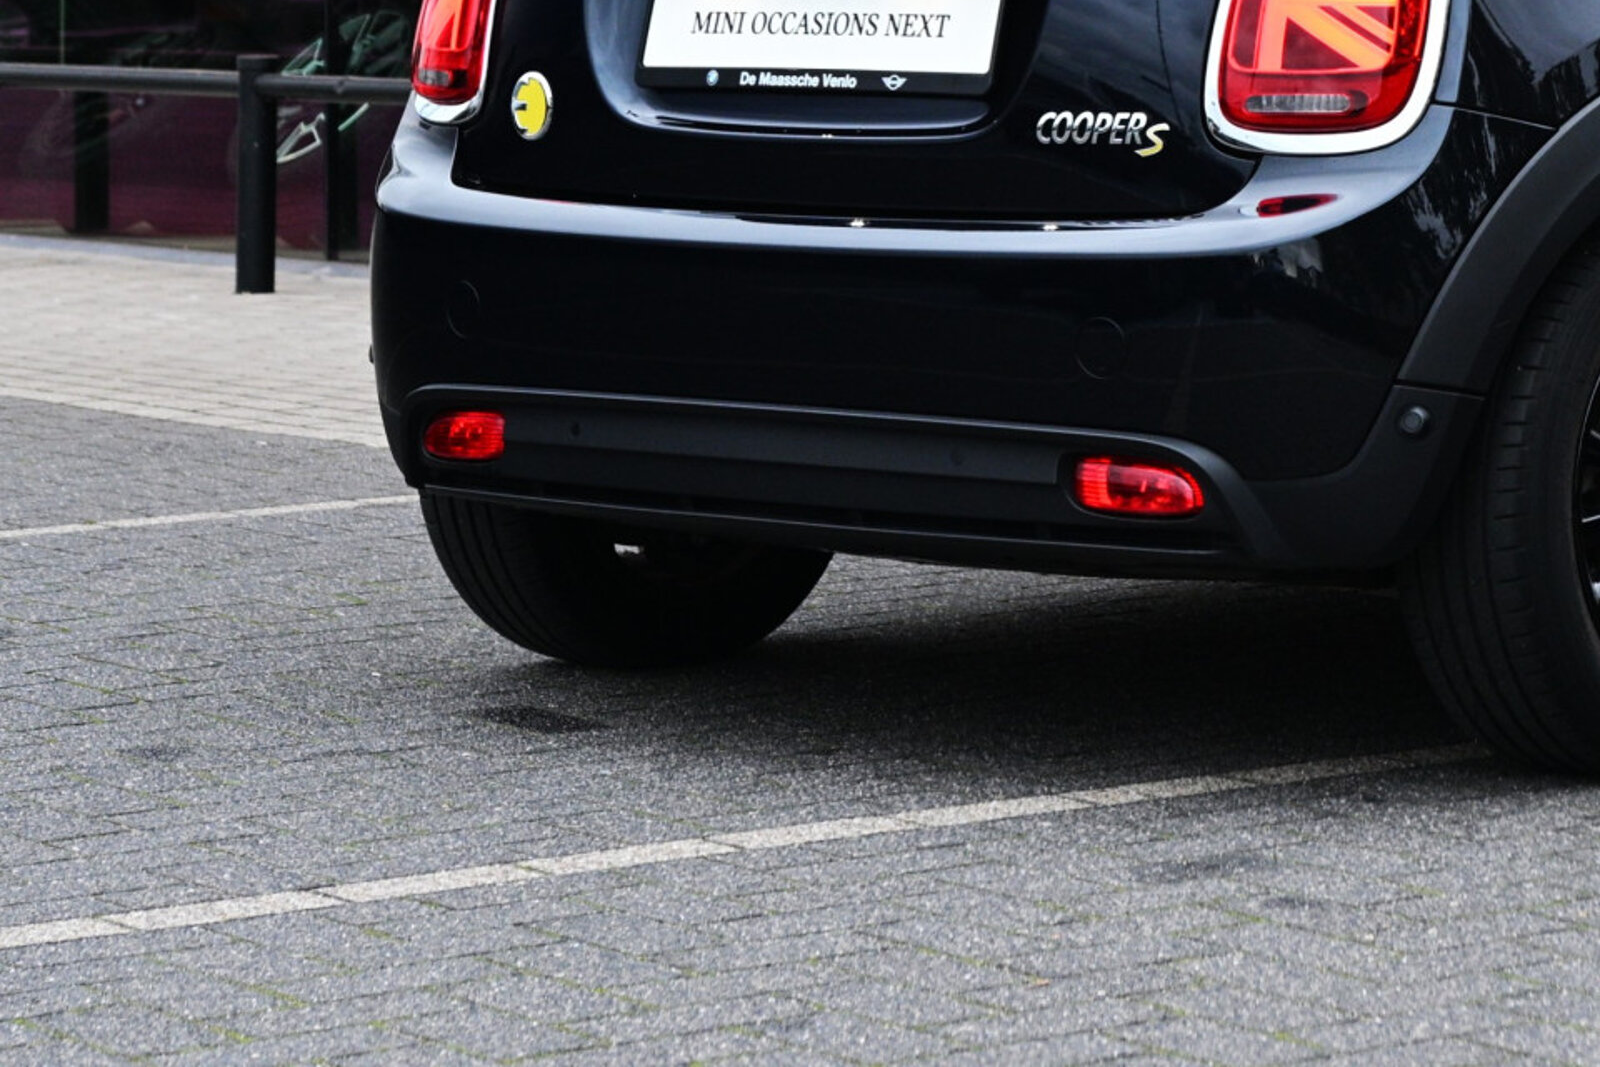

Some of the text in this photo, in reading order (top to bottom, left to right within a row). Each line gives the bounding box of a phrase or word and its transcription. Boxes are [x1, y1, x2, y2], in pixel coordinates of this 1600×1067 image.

[692, 12, 950, 38] MINI OCCASIONS NEXT
[739, 72, 857, 89] De Maassche Venlo
[1036, 110, 1147, 145] COOPER
